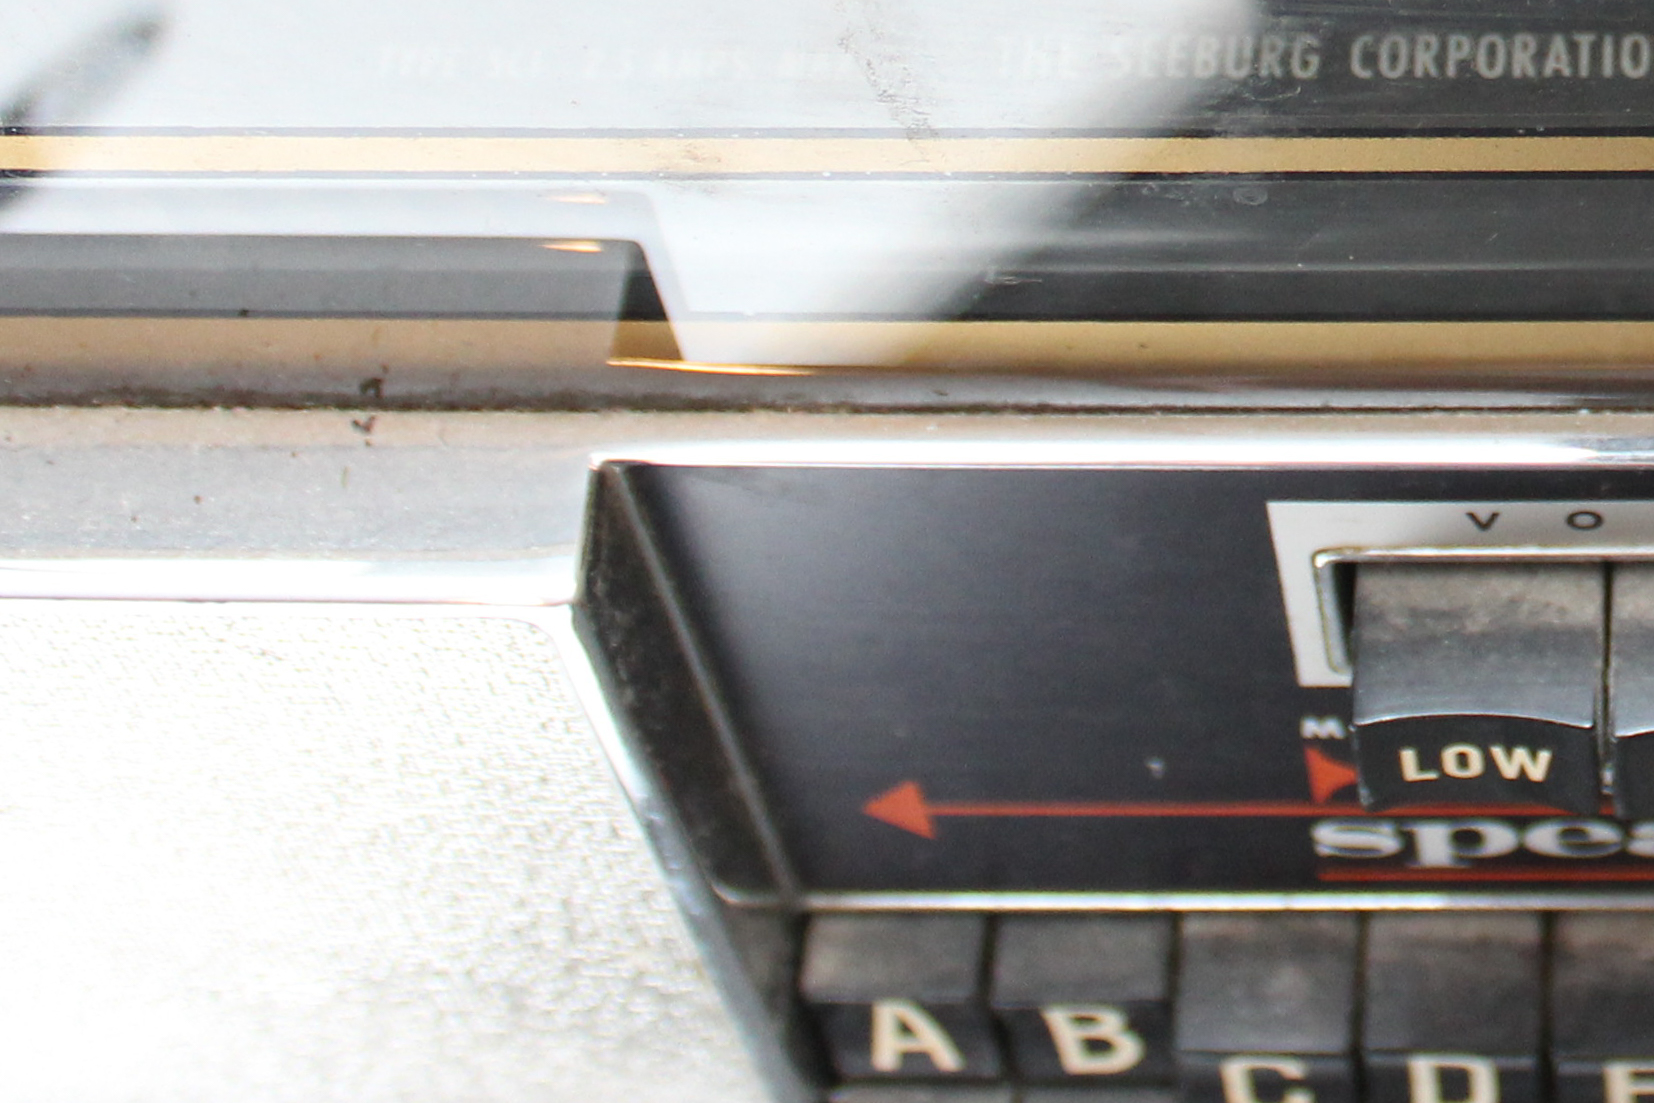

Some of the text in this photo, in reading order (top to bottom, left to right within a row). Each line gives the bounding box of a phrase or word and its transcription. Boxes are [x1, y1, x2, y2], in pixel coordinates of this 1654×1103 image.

[1109, 33, 1321, 80] SEEBURG
[1399, 741, 1553, 784] LOW
[869, 999, 966, 1072] A
[1040, 1001, 1146, 1076] B
[1219, 1053, 1315, 1103] C
